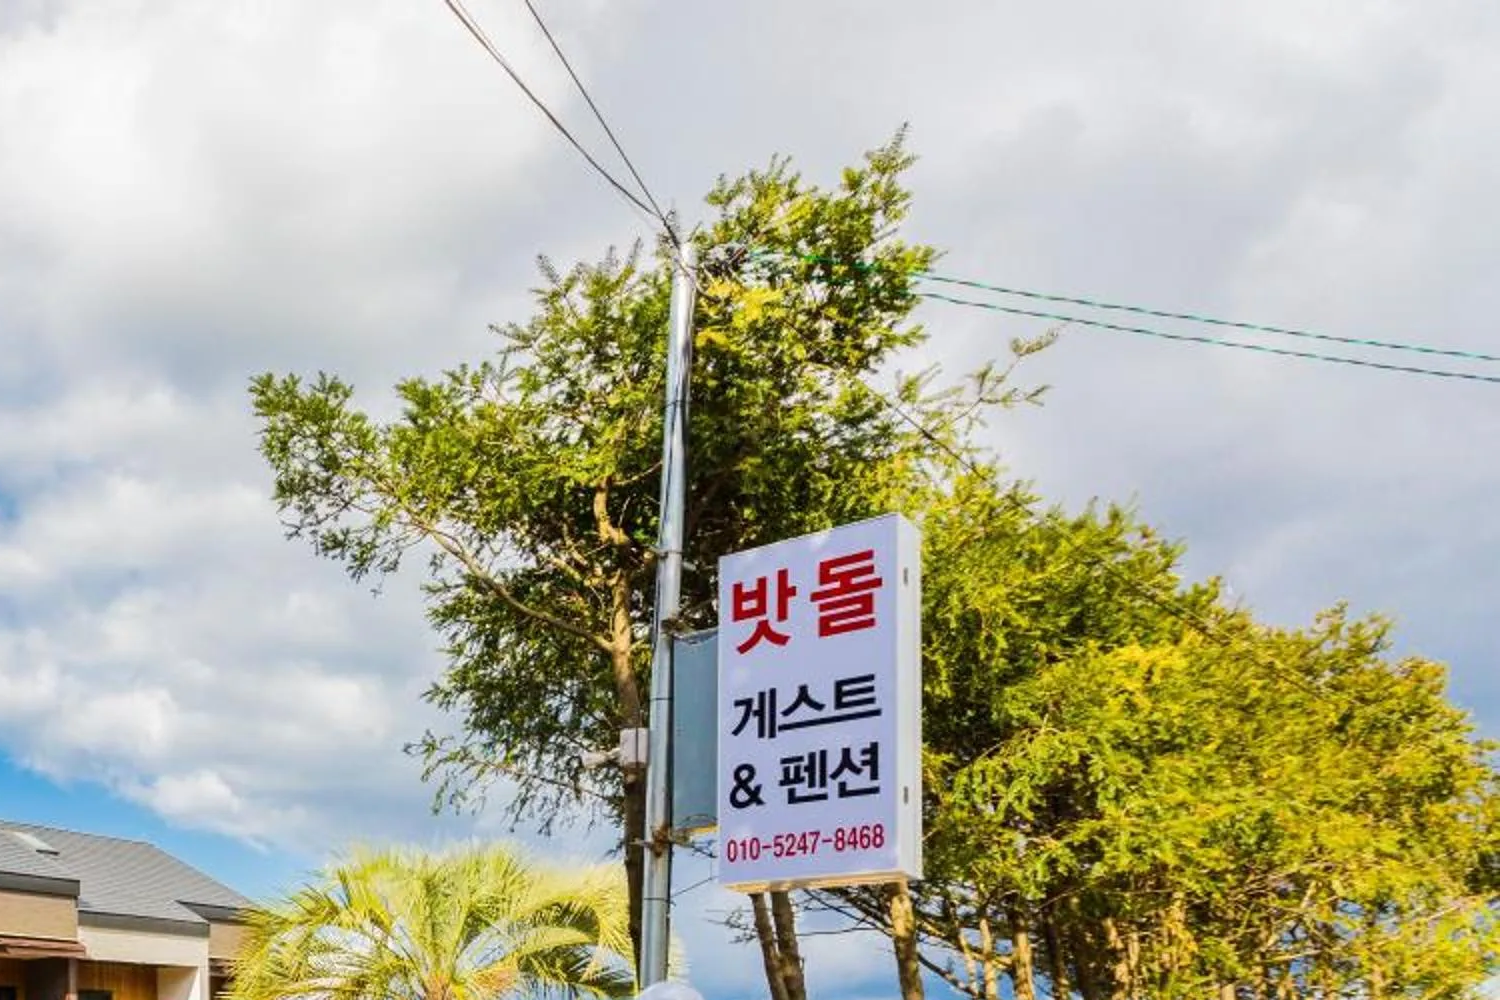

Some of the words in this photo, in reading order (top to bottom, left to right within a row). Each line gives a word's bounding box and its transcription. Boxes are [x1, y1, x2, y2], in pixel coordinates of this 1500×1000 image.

[731, 673, 882, 740] 게스트
[728, 762, 767, 810] &
[777, 741, 880, 805] 펜션
[726, 823, 885, 863] 010-5247-8468
